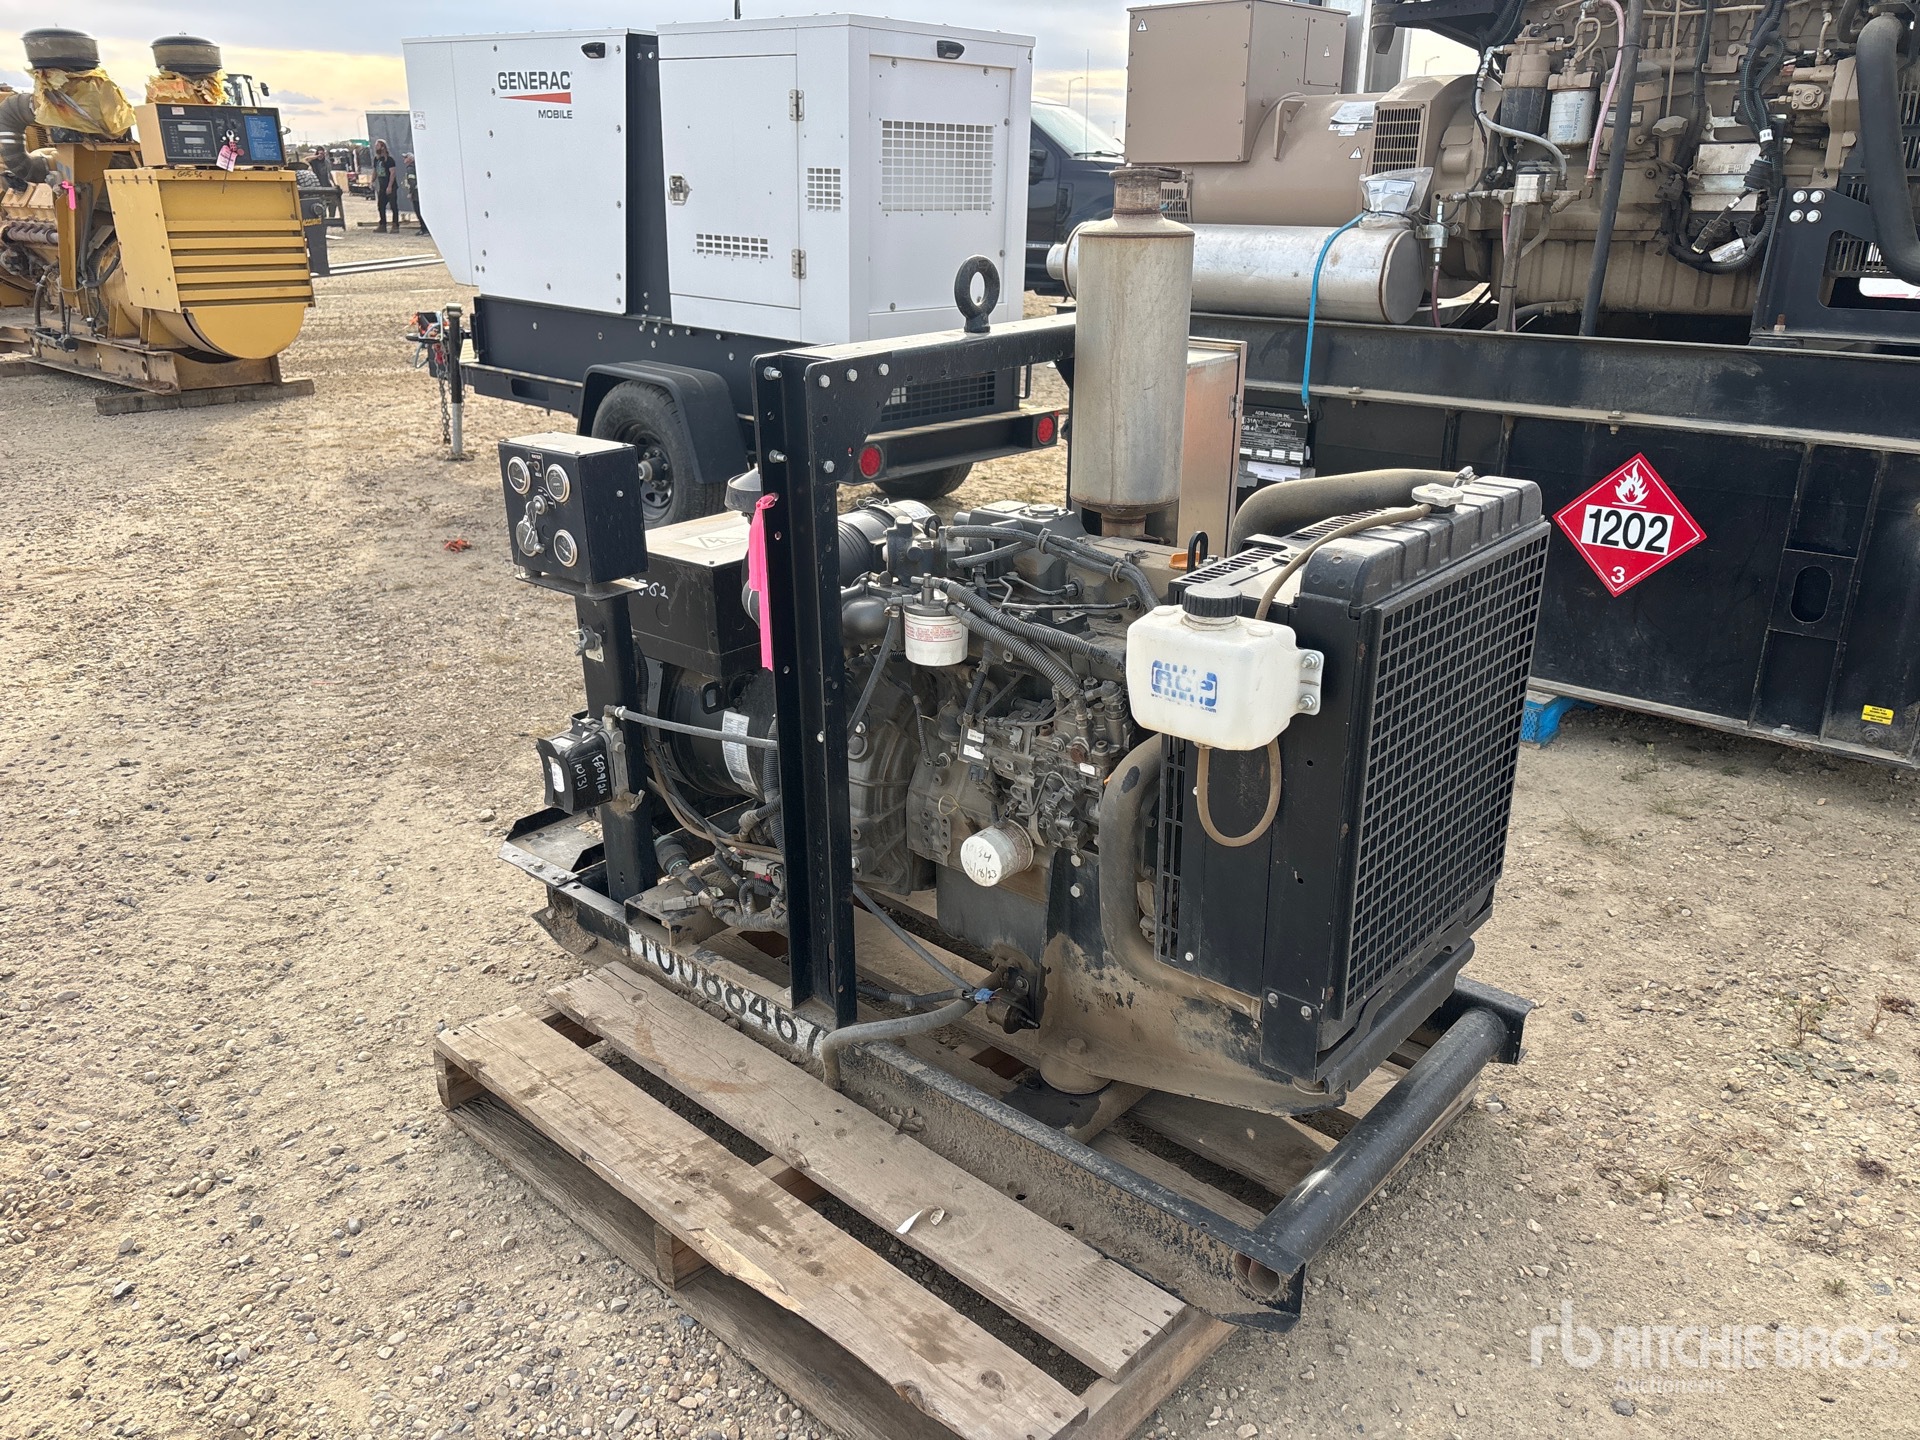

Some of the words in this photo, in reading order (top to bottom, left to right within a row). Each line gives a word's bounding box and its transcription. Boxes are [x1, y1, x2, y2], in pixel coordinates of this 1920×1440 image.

[498, 71, 571, 90] GENERAC
[538, 109, 573, 119] MOBILE
[1588, 508, 1668, 553] 1202
[1611, 566, 1626, 583] 3
